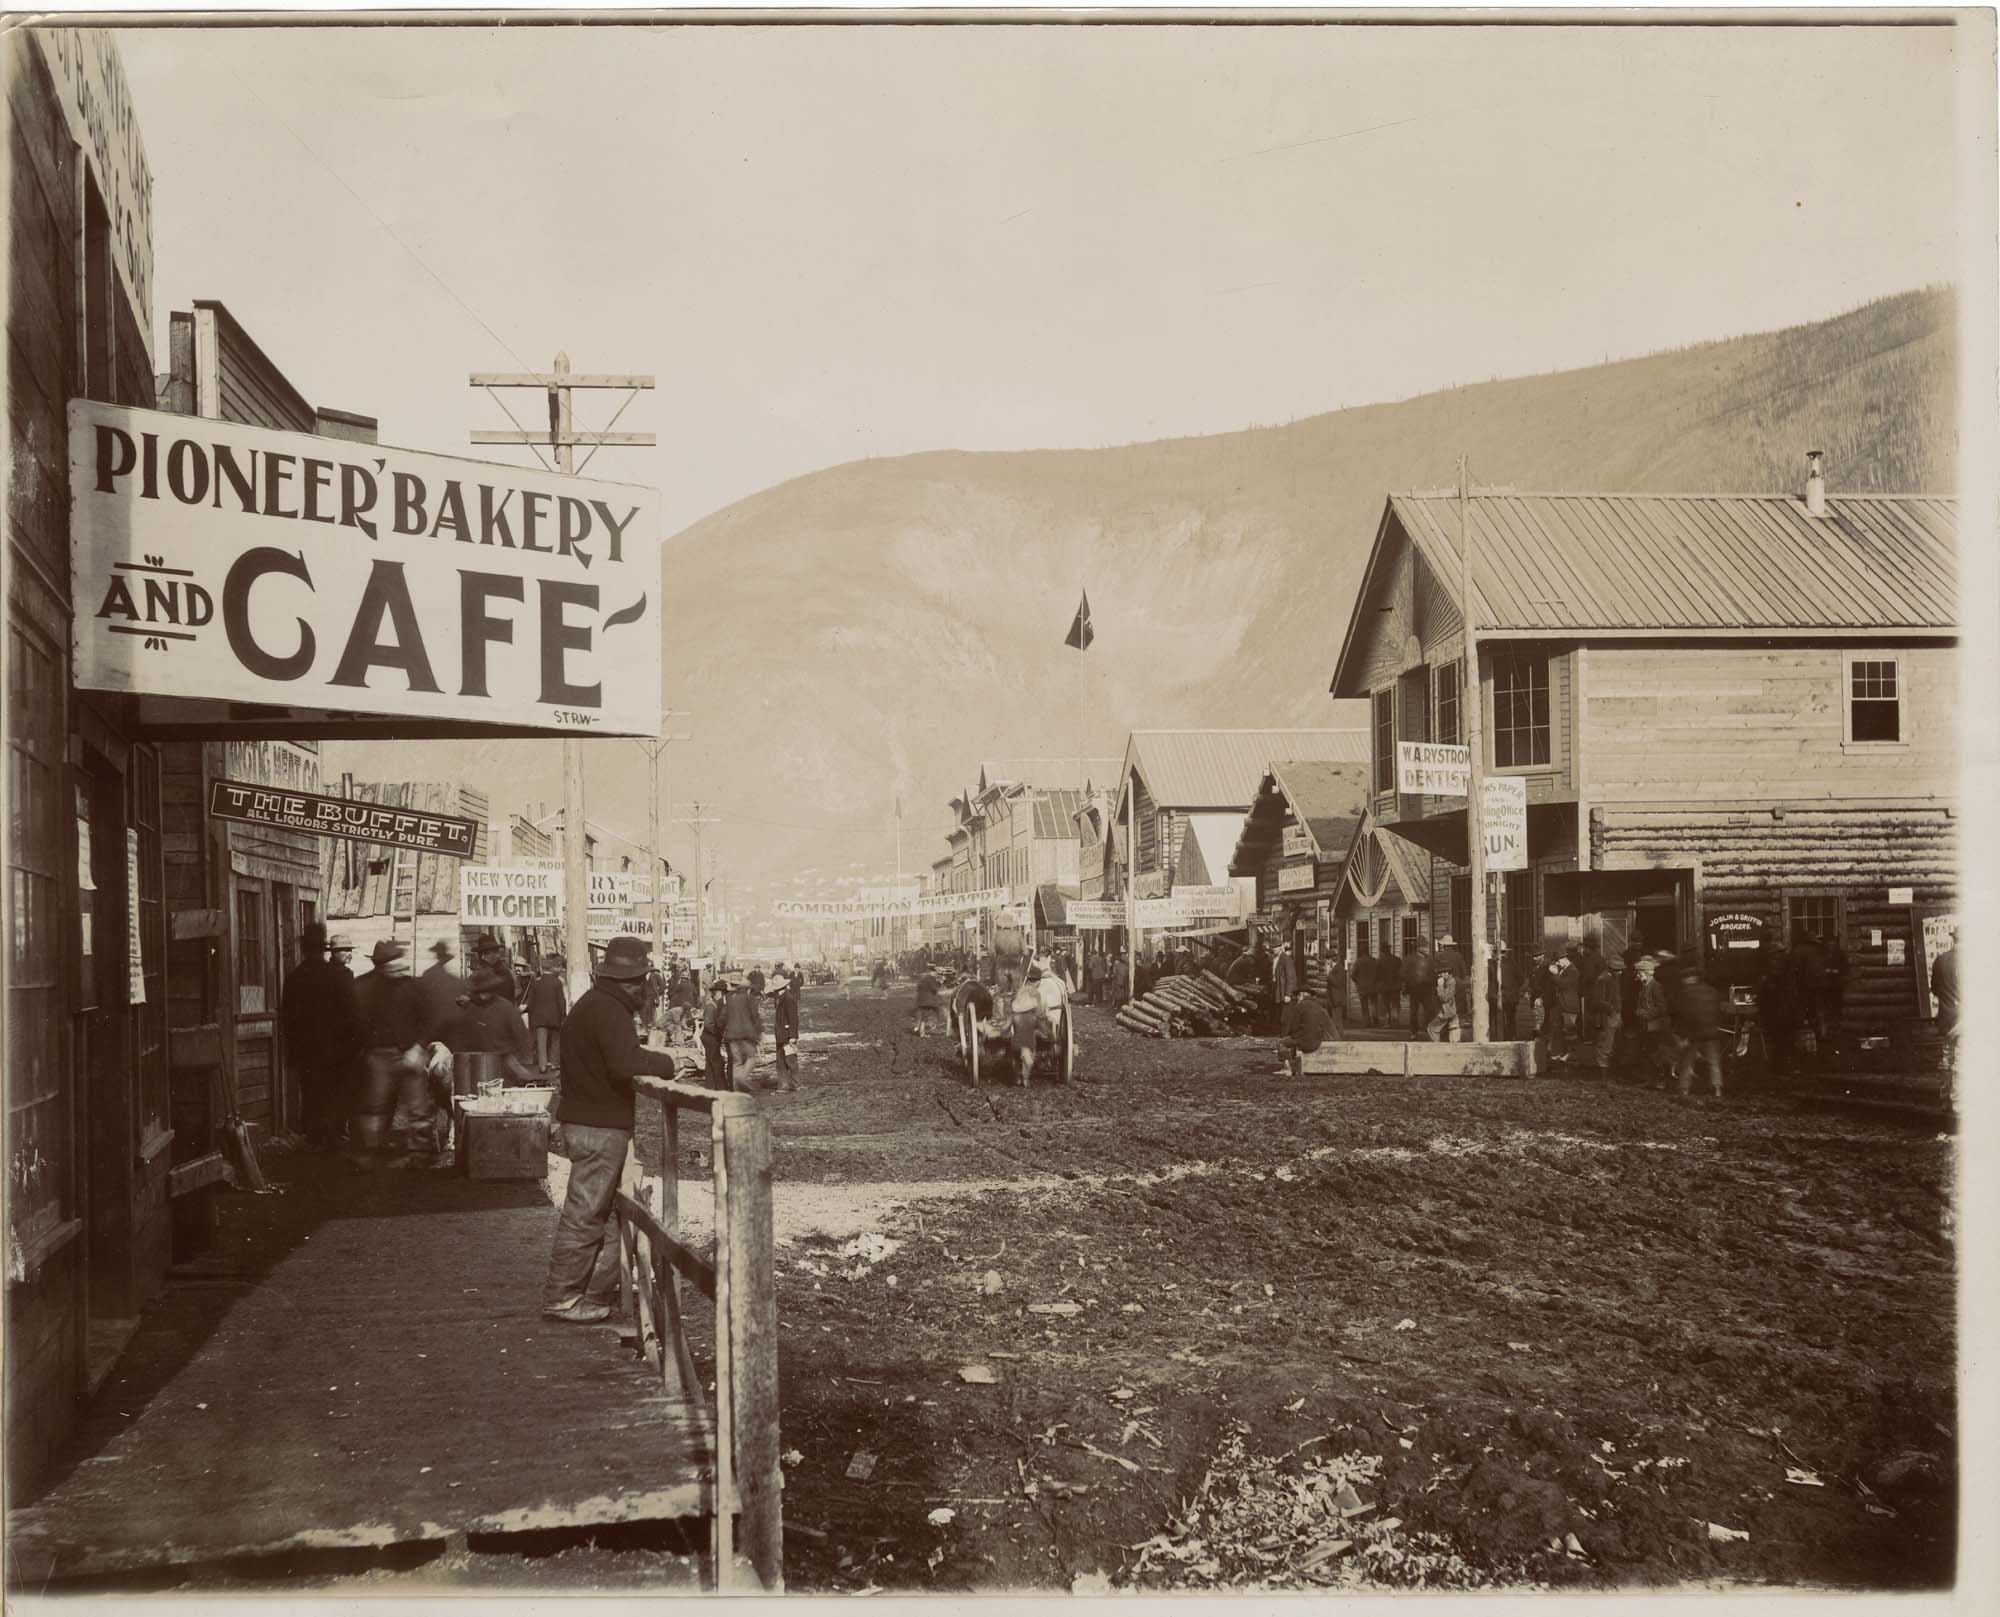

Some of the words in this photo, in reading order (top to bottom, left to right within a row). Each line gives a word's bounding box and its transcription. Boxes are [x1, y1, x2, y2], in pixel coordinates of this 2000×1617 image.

[392, 471, 640, 569] BAKERY
[94, 574, 214, 627] AND
[222, 546, 602, 709] CAFE
[1405, 769, 1469, 788] DENTIST
[227, 788, 306, 816] THE
[246, 808, 270, 820] ALL
[275, 813, 328, 830] LIQUORS
[467, 872, 500, 887] NEW
[504, 874, 548, 889] YORK
[467, 894, 557, 918] KITCHEN
[777, 899, 913, 914] COMBINATION
